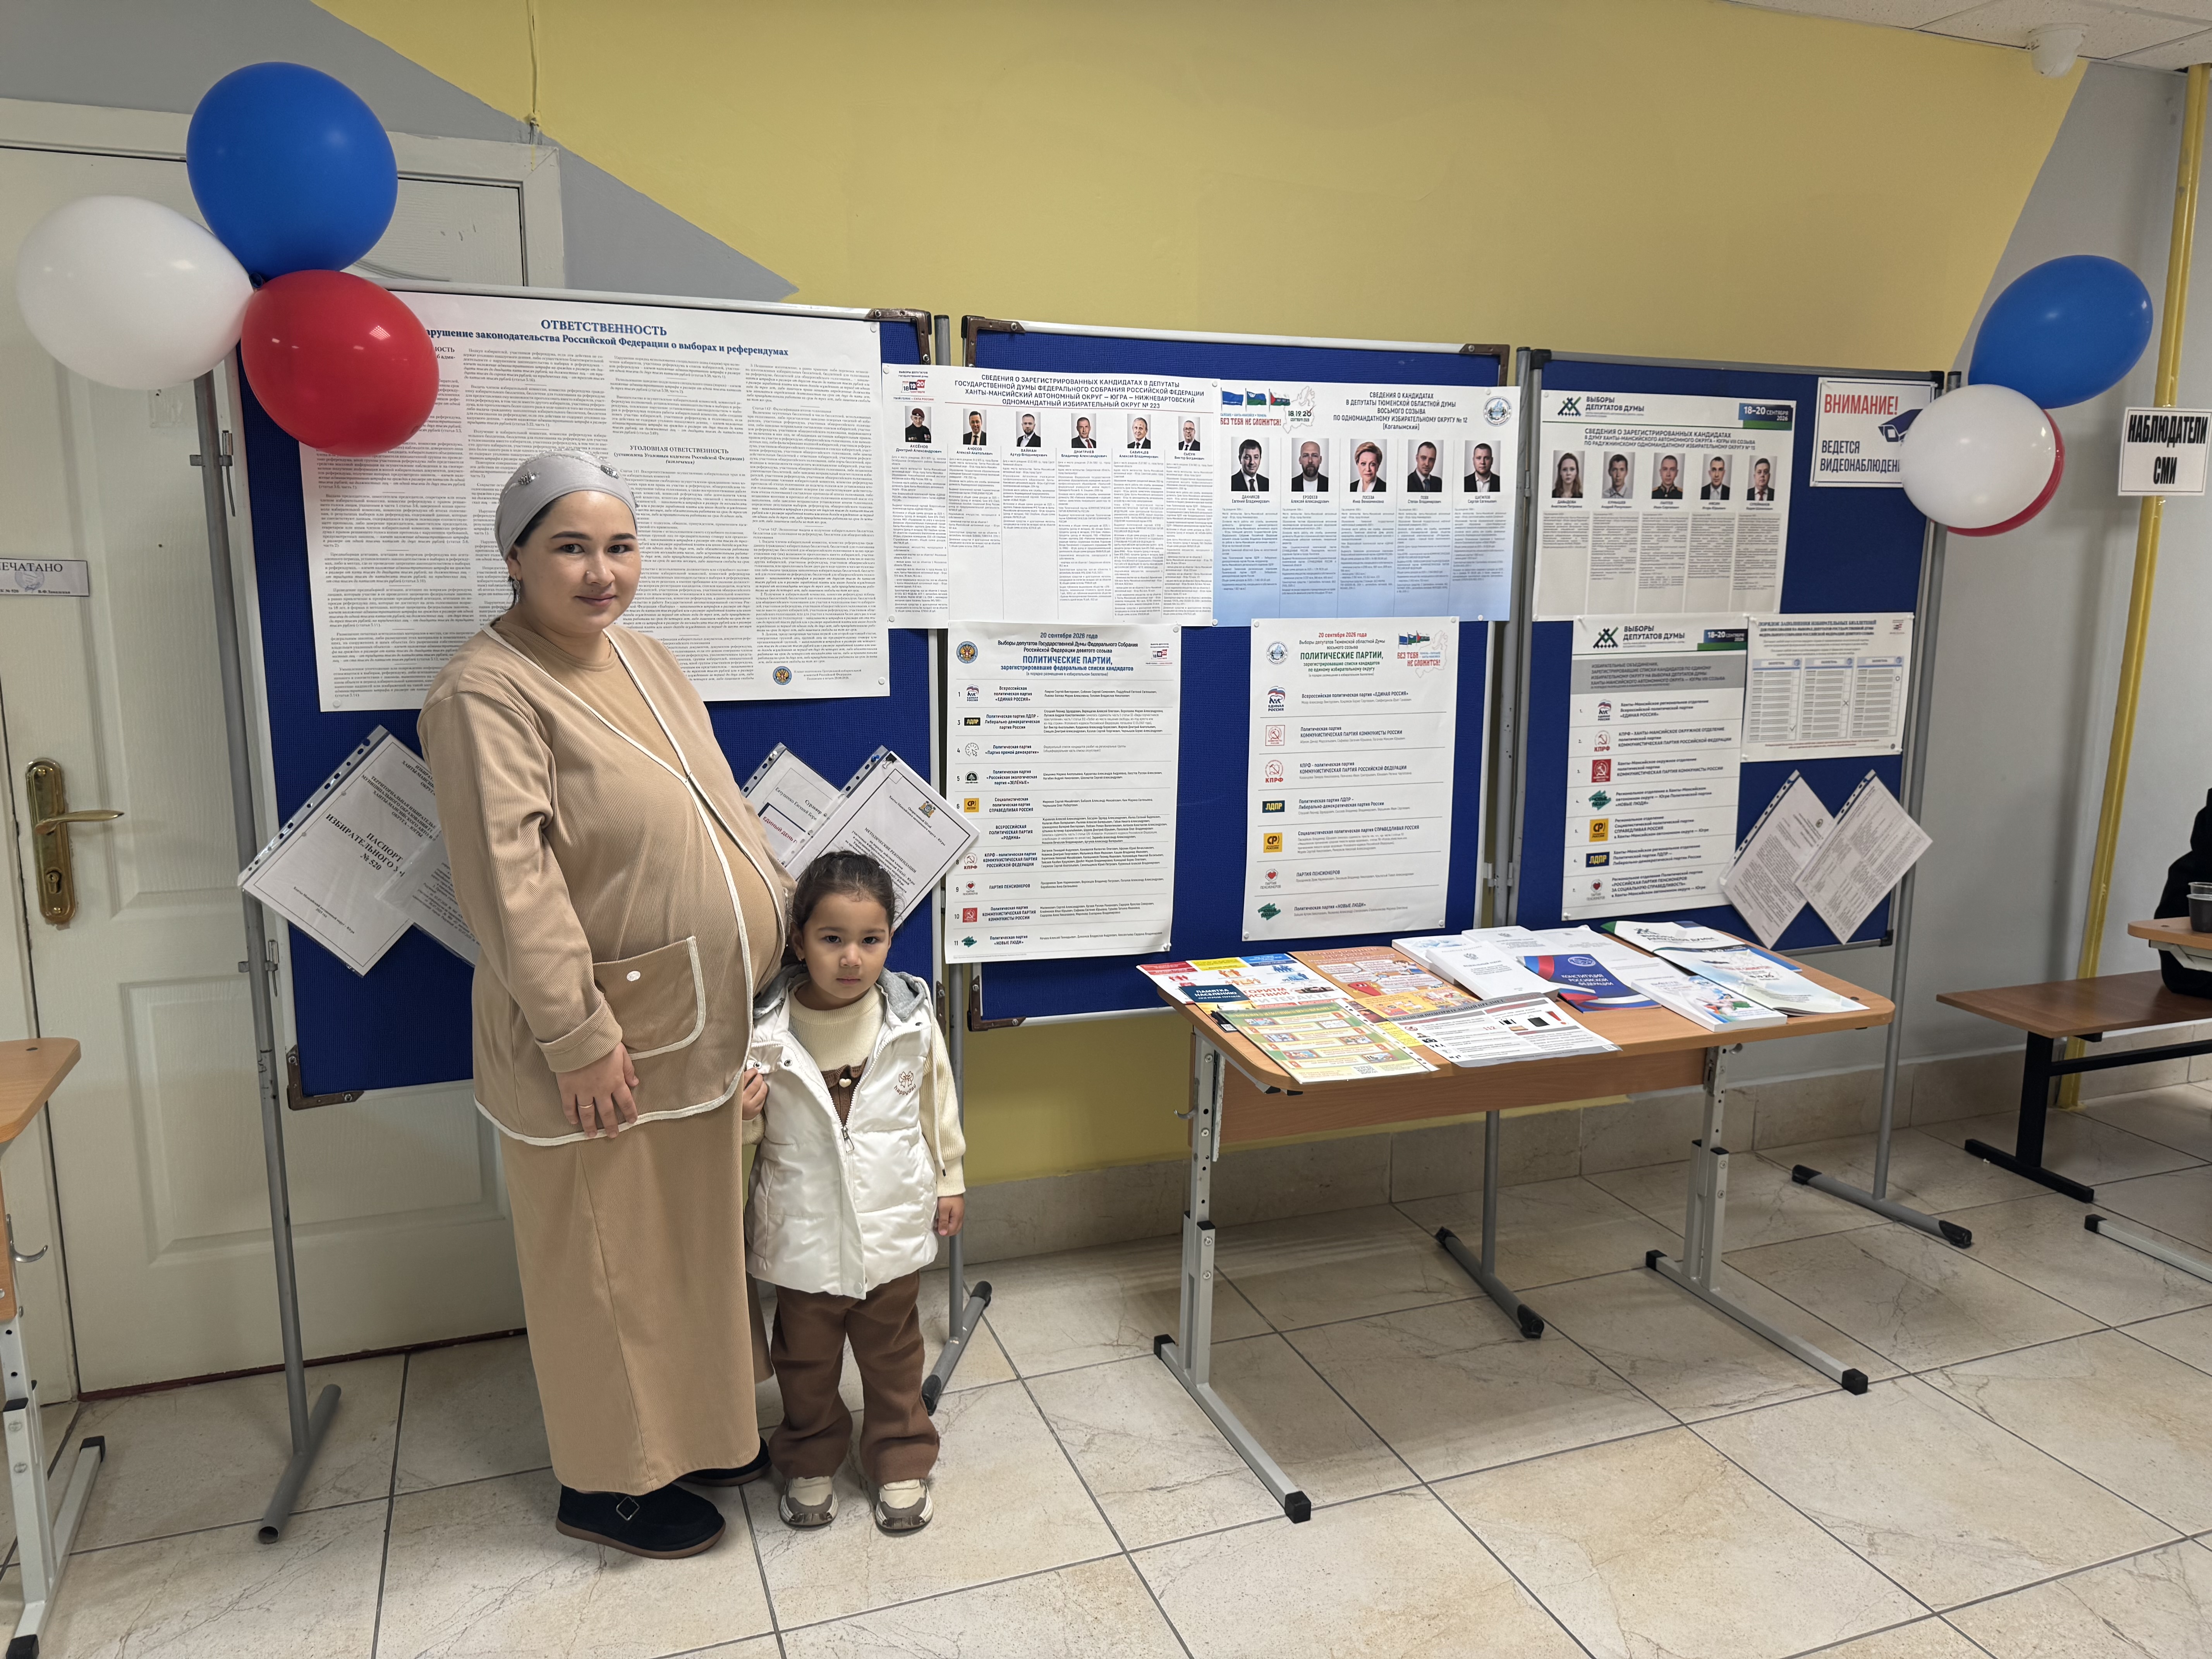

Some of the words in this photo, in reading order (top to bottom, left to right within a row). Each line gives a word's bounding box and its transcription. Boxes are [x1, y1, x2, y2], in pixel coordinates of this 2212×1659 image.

[541, 319, 667, 335] ОТВЕТСТВЕННОСТЬ
[475, 332, 560, 342] законодательства
[562, 334, 616, 345] Российской
[618, 337, 669, 349] Федерации
[678, 342, 716, 353] выборах
[726, 344, 788, 357] референдумах
[955, 380, 1015, 389] ГОСУДАРСТВЕННОЙ
[1021, 376, 1097, 385] ЗАРЕГИСТРИРОВАННЫХ
[965, 388, 1032, 398] ХАНТЫ-МАНСИЙСКИЙ
[1135, 395, 1194, 403] НИЖНЕВАРТОВСКИЙ
[1824, 393, 1898, 415] ВНИМАНИЕ!
[2127, 414, 2208, 448] НАБЛЮДАТЕЛИ
[1821, 440, 1860, 455] ВЕДЕТСЯ
[2153, 456, 2177, 484] СМИ
[0, 562, 63, 572] ЕЧАТАНО
[1623, 633, 1662, 641] ДЕПУТАТОВ
[1023, 656, 1080, 664] ПОЛИТИЧЕСКИЕ
[1082, 656, 1112, 665] ПАРТИИ,
[1300, 651, 1354, 660] ПОЛИТИЧЕСКИЕ
[1356, 651, 1383, 659] ПАРТИИ,
[1265, 802, 1282, 811] ЛДПР
[763, 816, 782, 832] ЕДИНЫЙ
[781, 831, 793, 841] ДЕНЬ
[326, 813, 393, 867] ИЗБИРАТЕЛЬНОГО
[366, 833, 402, 862] ПАСПОРТ
[864, 827, 891, 851] МЕТОДИЧЕСКИЕ
[890, 849, 917, 873] РЕКОМЕНДАЦИИ
[360, 853, 369, 861] №
[368, 859, 381, 870] 520
[1589, 854, 1607, 864] ЛДПР
[894, 1084, 916, 1096] happyday
